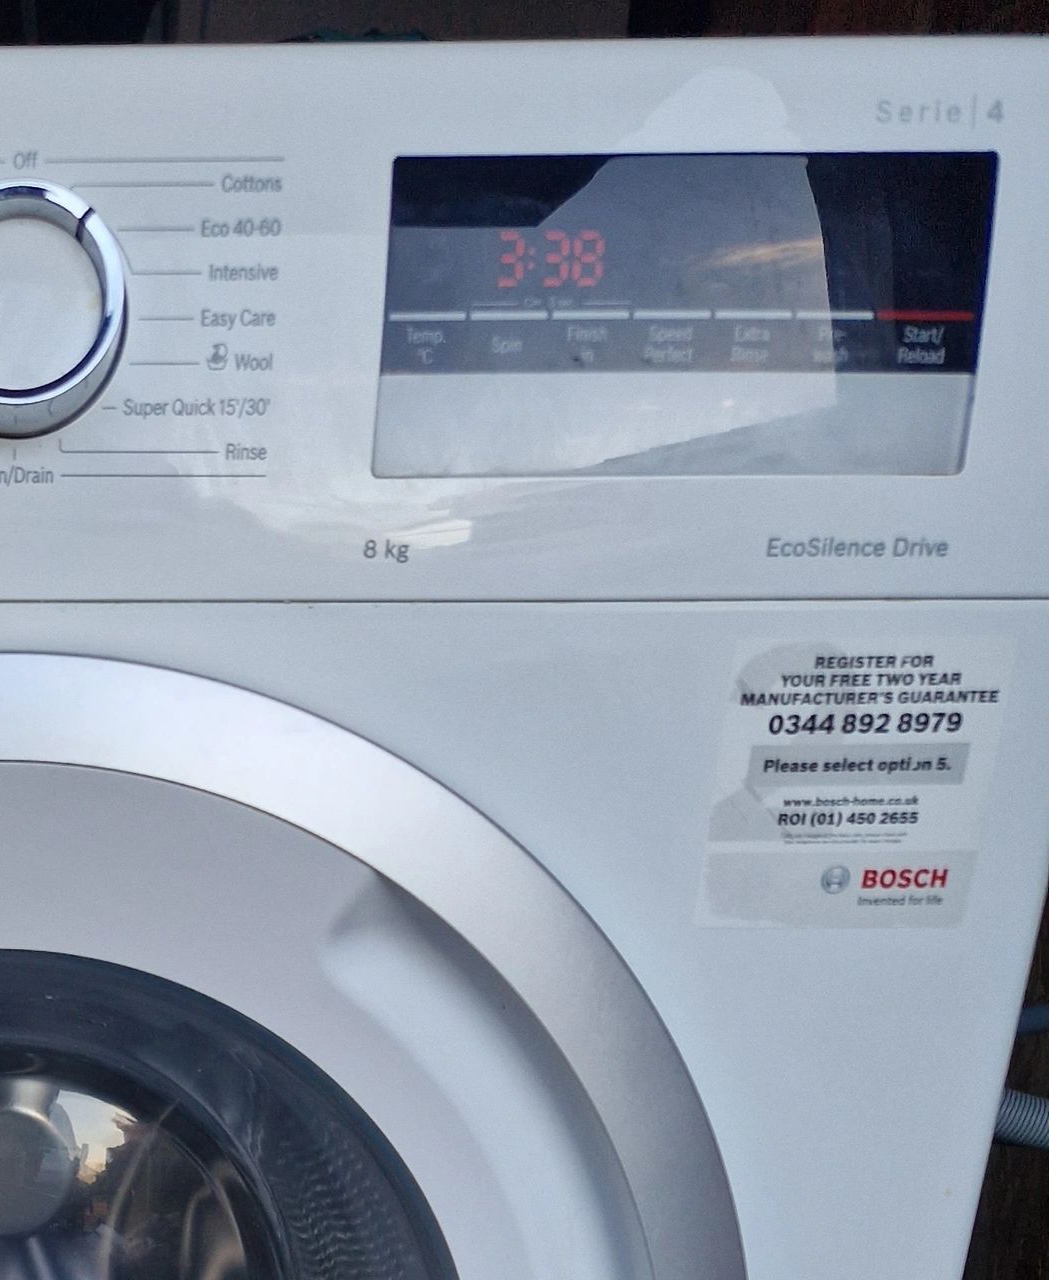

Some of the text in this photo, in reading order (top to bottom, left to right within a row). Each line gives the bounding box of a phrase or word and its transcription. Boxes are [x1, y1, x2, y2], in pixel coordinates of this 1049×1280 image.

[875, 98, 1005, 124] Serie 4
[13, 150, 38, 170] Off
[221, 174, 284, 193] Cottons
[200, 218, 283, 238] Eco 40-60
[496, 229, 606, 289] 3:38
[208, 264, 279, 282] Intensive
[200, 308, 277, 331] Easy Care
[406, 326, 447, 345] Temp.
[234, 353, 274, 371] Wool
[123, 398, 168, 419] Super
[171, 398, 215, 416] Quick
[225, 443, 268, 460] Rinse
[363, 538, 409, 564] 8 kg
[765, 537, 950, 558] EcoSilence Drive
[814, 655, 935, 669] REGISTER FOR
[780, 672, 962, 688] YOUR FREE TWO YEAR
[740, 689, 1000, 706] MANUFACTURER'S GUARANTEE
[768, 712, 963, 735] 0344 892 8979
[763, 758, 819, 773] Please
[822, 757, 874, 772] select
[935, 756, 952, 771] 5.
[777, 812, 920, 828] ROI (01) 450 2655
[861, 868, 949, 889] BOSCH
[857, 895, 944, 906] Invented for life
